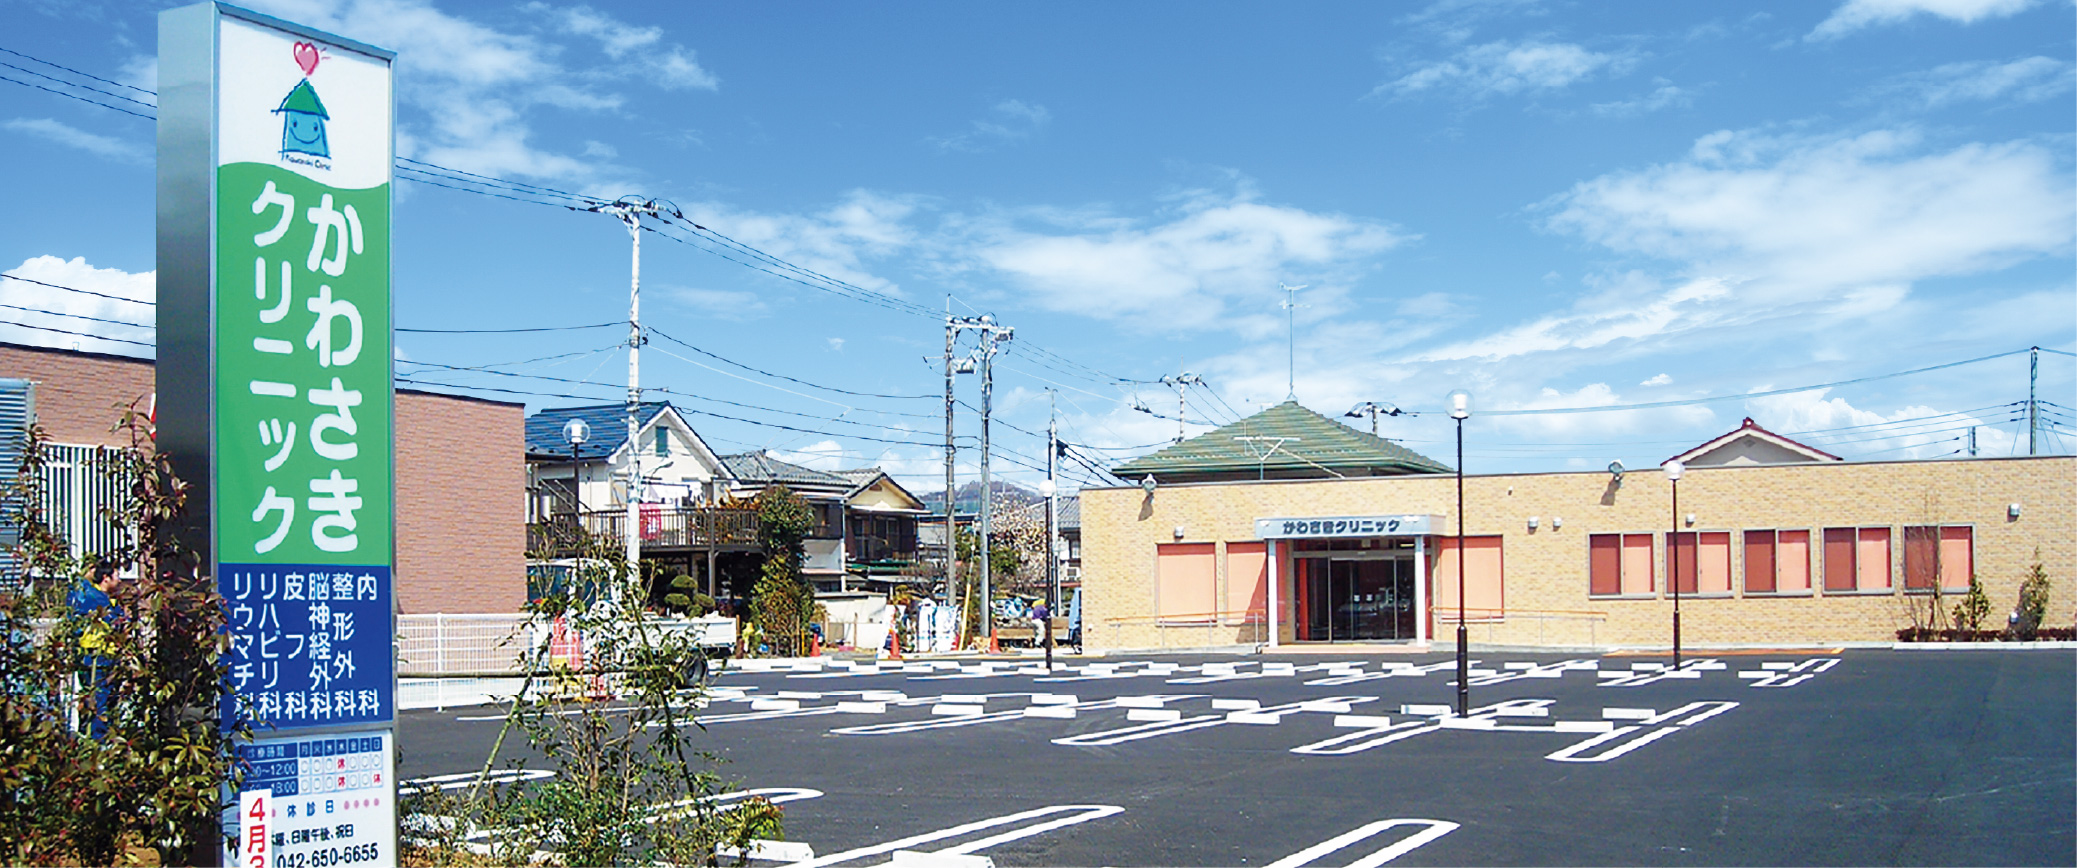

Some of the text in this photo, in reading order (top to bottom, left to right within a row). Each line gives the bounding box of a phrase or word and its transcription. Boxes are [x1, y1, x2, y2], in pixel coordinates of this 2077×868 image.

[249, 180, 297, 554] クリニック
[306, 193, 364, 552] かわさき
[1283, 519, 1400, 534] かわさきクリニック
[258, 572, 282, 720] リハビリ科
[283, 571, 307, 720] 皮フ科
[308, 571, 332, 720] 脳神経外科
[332, 572, 356, 717] 整形外科
[357, 572, 380, 716] 内科
[277, 842, 379, 868] 042-650-6655
